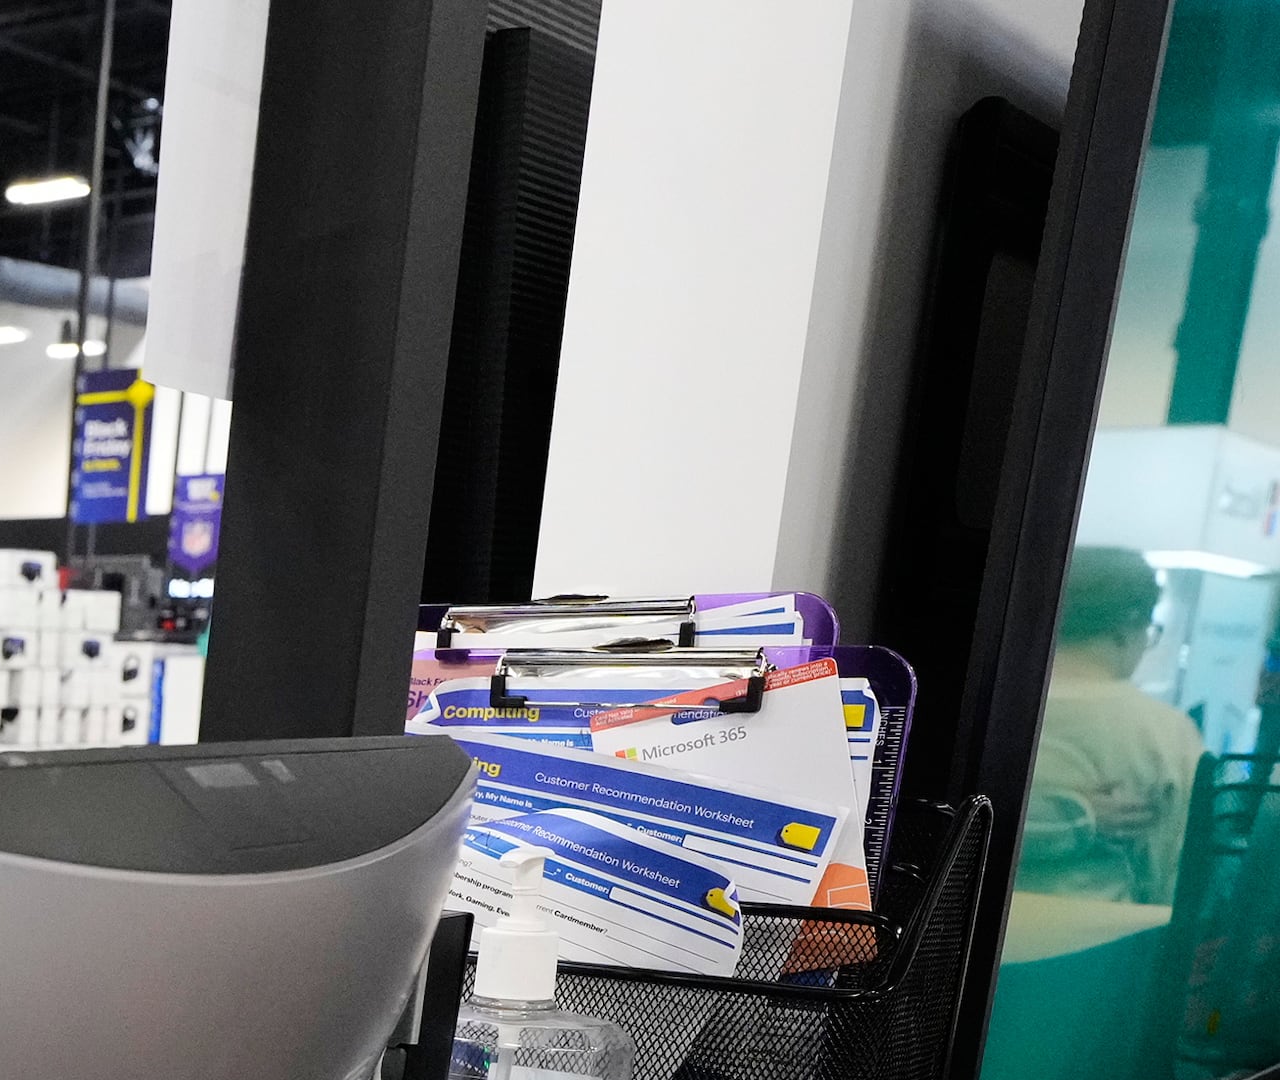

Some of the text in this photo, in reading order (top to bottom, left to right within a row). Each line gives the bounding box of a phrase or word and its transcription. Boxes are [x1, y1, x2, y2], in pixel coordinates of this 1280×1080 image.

[443, 705, 541, 723] Computing
[574, 707, 605, 718] Custo
[876, 709, 889, 746] INCHES
[642, 726, 747, 760] Microsoft 365
[500, 795, 524, 807] Name
[535, 772, 754, 829] Customer Recommendation Worksheet
[533, 825, 619, 867] Recommendation
[621, 859, 681, 889] Worksheet
[454, 872, 514, 900] bership program
[536, 904, 608, 934] rrent Cardmember?
